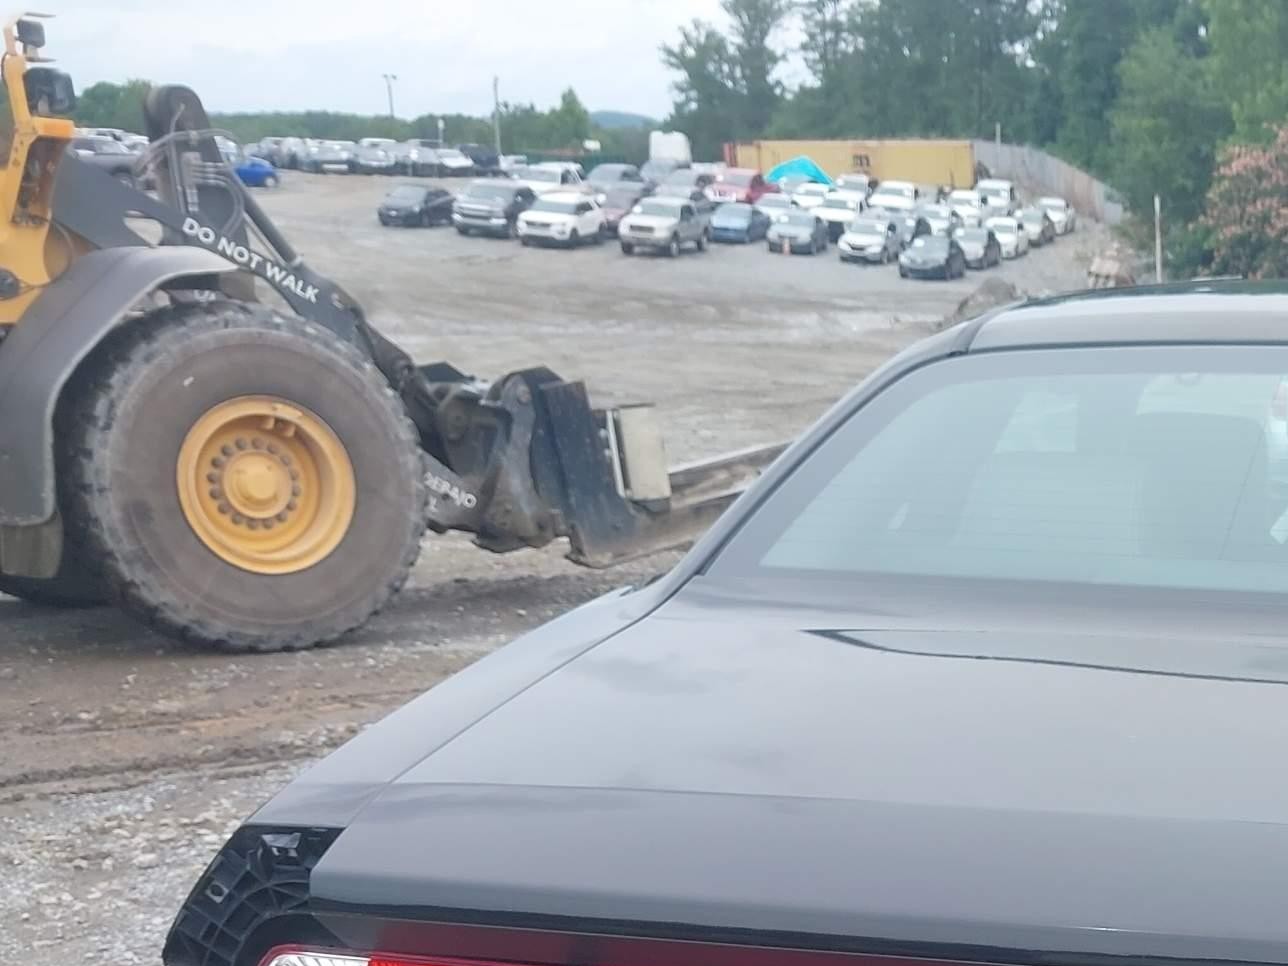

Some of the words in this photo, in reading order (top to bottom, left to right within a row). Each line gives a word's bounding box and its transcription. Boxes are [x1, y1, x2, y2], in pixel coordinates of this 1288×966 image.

[182, 217, 216, 245] DO
[217, 236, 263, 270] NOT
[264, 261, 320, 304] WALK
